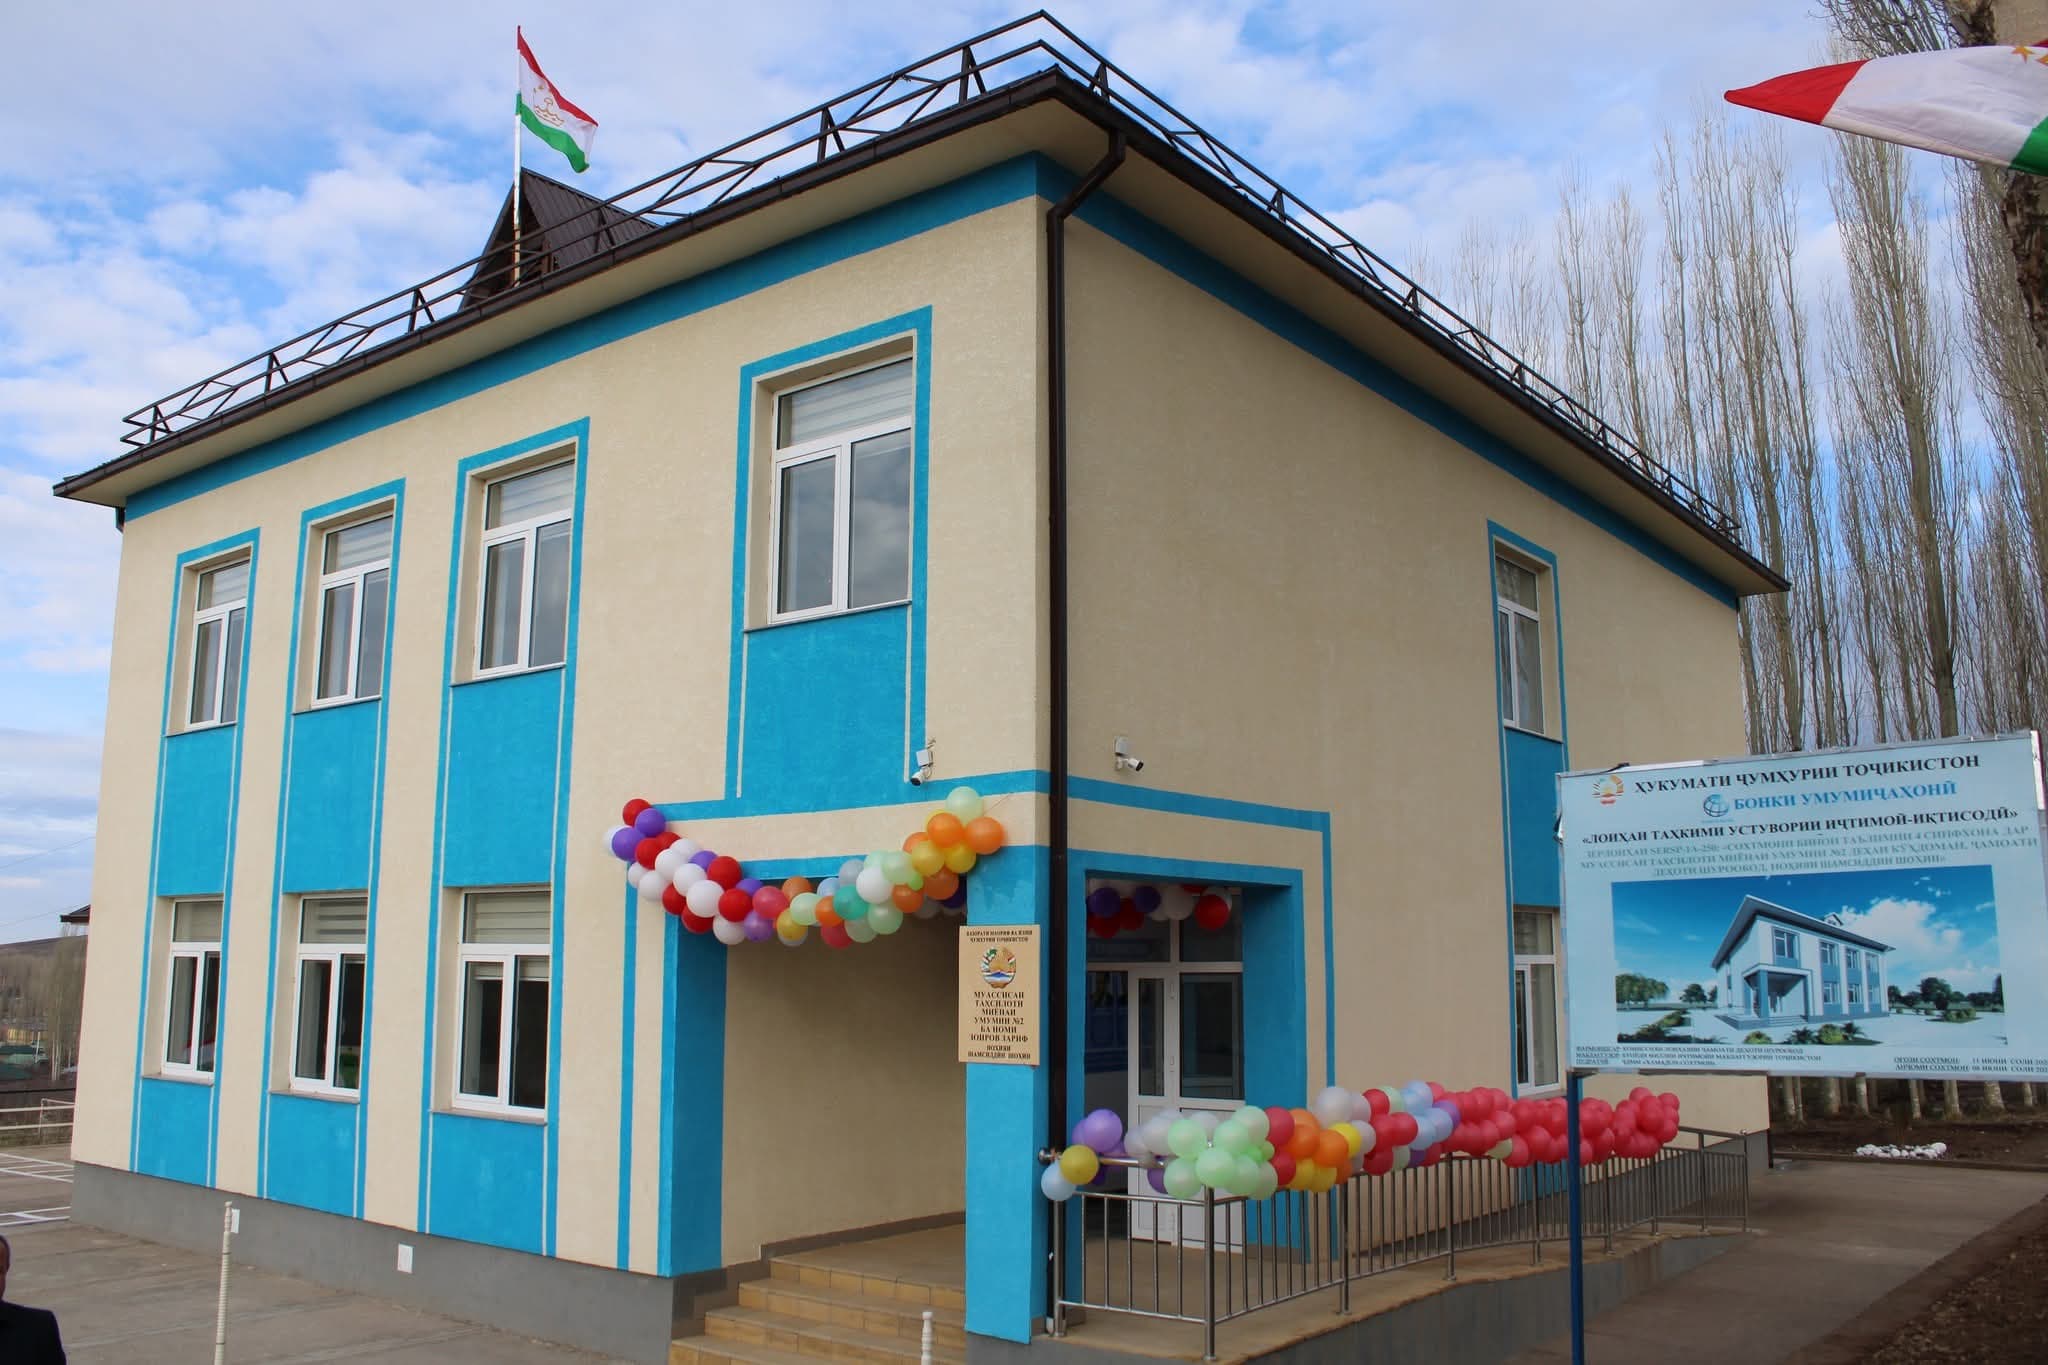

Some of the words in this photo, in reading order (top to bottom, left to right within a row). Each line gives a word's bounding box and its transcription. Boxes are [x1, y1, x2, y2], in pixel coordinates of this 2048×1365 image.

[1635, 775, 1732, 794] ҲУКУМАТИ
[1736, 766, 1838, 786] ҶУМҲУРИИ
[1843, 755, 1980, 777] ТОҶИКИСТОН
[1734, 794, 1796, 810] БОНКИ
[1651, 827, 1724, 841] ТАҲКИМИ
[1729, 820, 1820, 837] УСТУВОРИИ
[974, 991, 1024, 999] МУАССИСАИ
